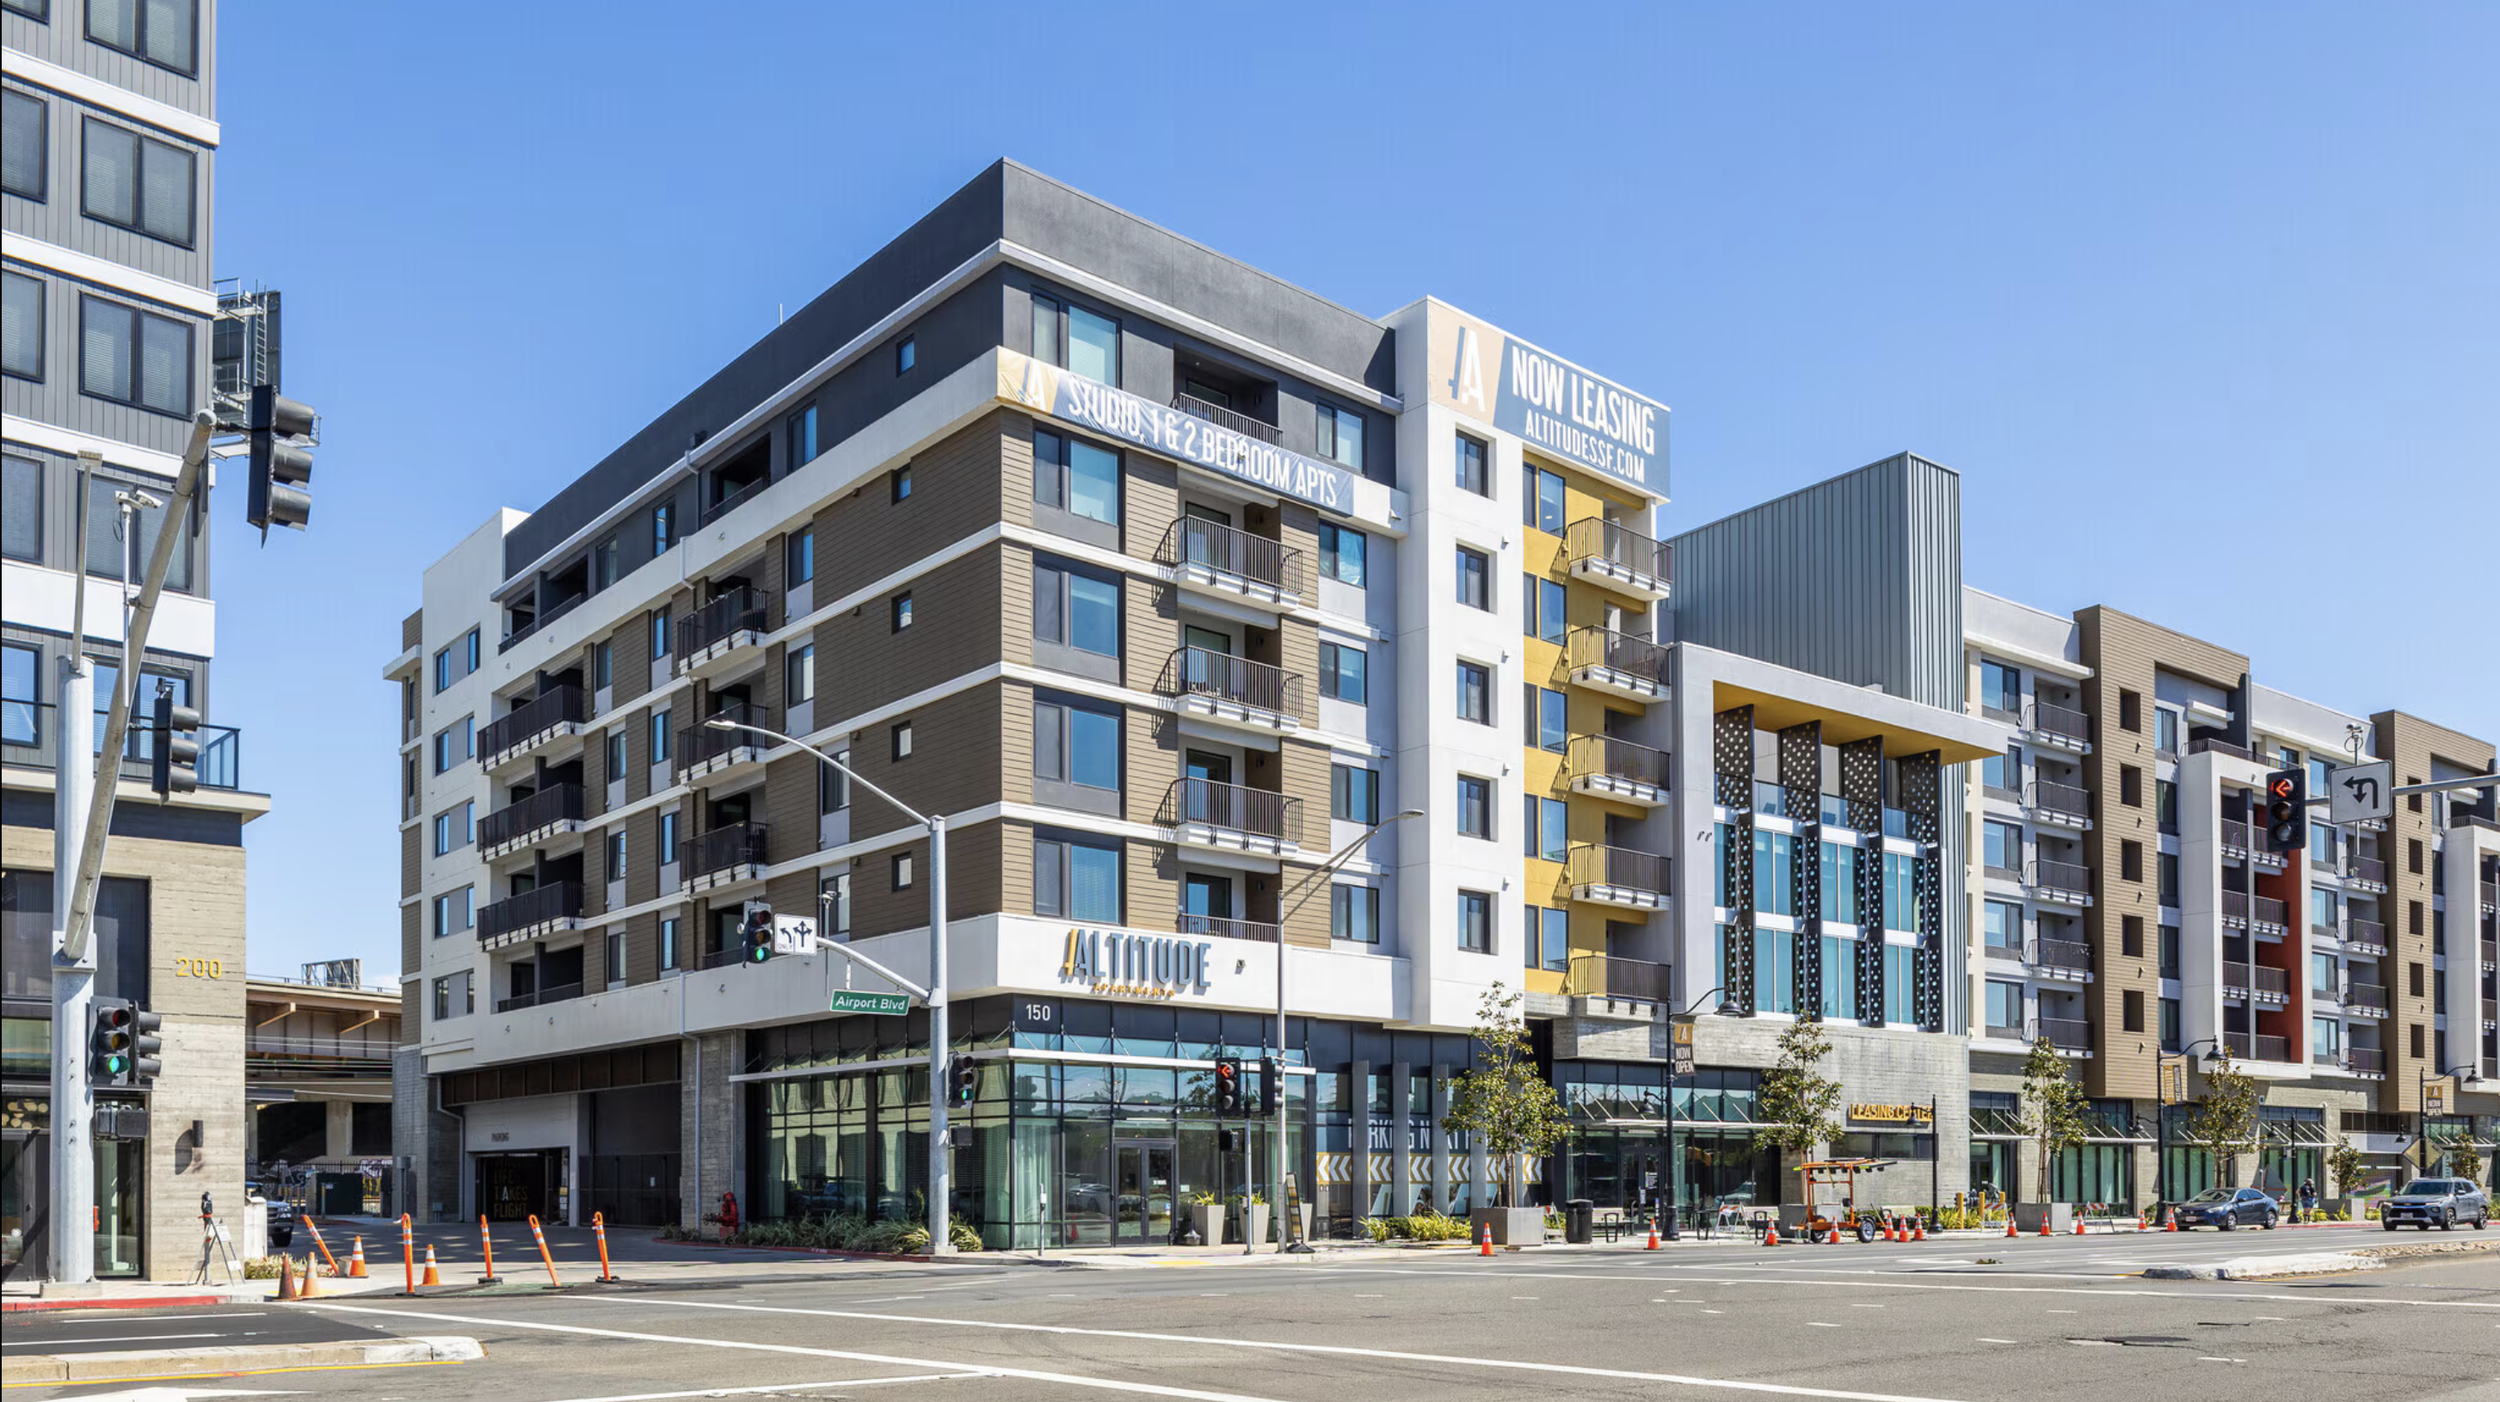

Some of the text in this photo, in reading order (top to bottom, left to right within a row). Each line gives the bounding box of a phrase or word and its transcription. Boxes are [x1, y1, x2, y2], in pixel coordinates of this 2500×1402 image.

[1512, 345, 1655, 456] NOW LEASING
[1068, 377, 1337, 507] STUDIO, 1 & 2 BEDROOM APTS
[1525, 408, 1645, 484] ALTITUDESSF.COM
[176, 957, 222, 978] 200
[1064, 929, 1211, 987] ALTITUDE
[836, 995, 906, 1011] Airport Blvd
[1025, 1003, 1051, 1021] 150
[1675, 1046, 1691, 1060] NOW
[1675, 1060, 1694, 1073] OPEN
[1851, 1103, 1894, 1119] LEASING
[1348, 1118, 1415, 1149] RKIG
[493, 1185, 528, 1202] TAKES
